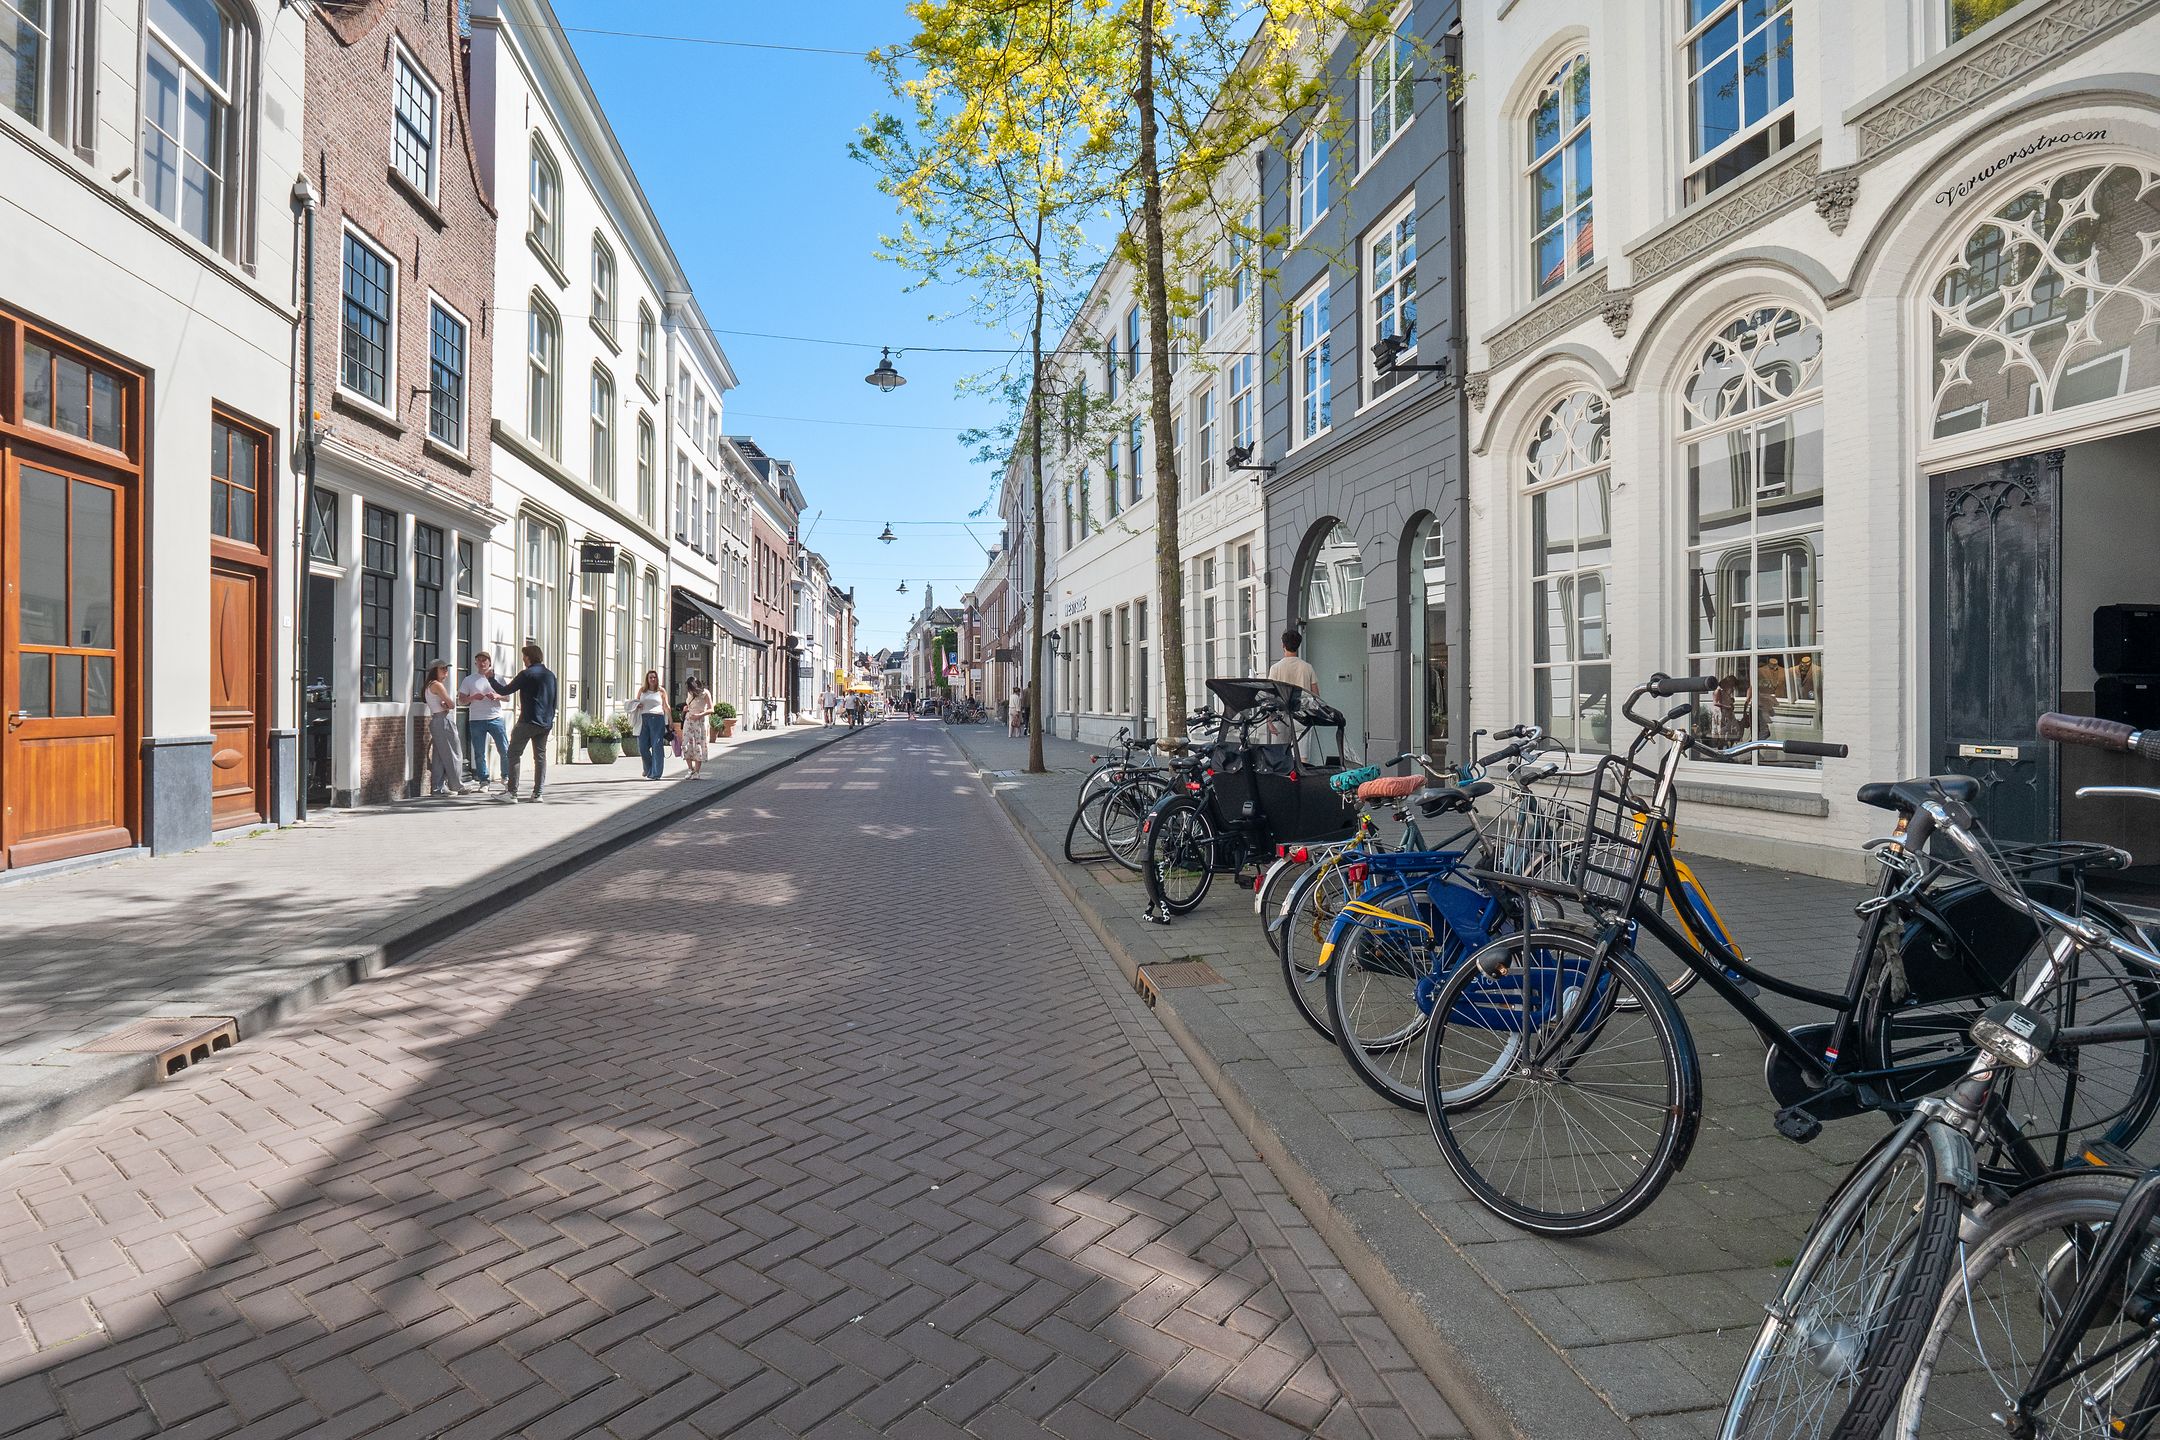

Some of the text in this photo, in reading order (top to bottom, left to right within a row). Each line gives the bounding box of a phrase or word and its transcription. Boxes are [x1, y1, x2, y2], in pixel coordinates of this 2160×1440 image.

[1934, 127, 2108, 207] Verwersstroom
[673, 643, 699, 651] PAUW
[1371, 632, 1392, 647] MAX
